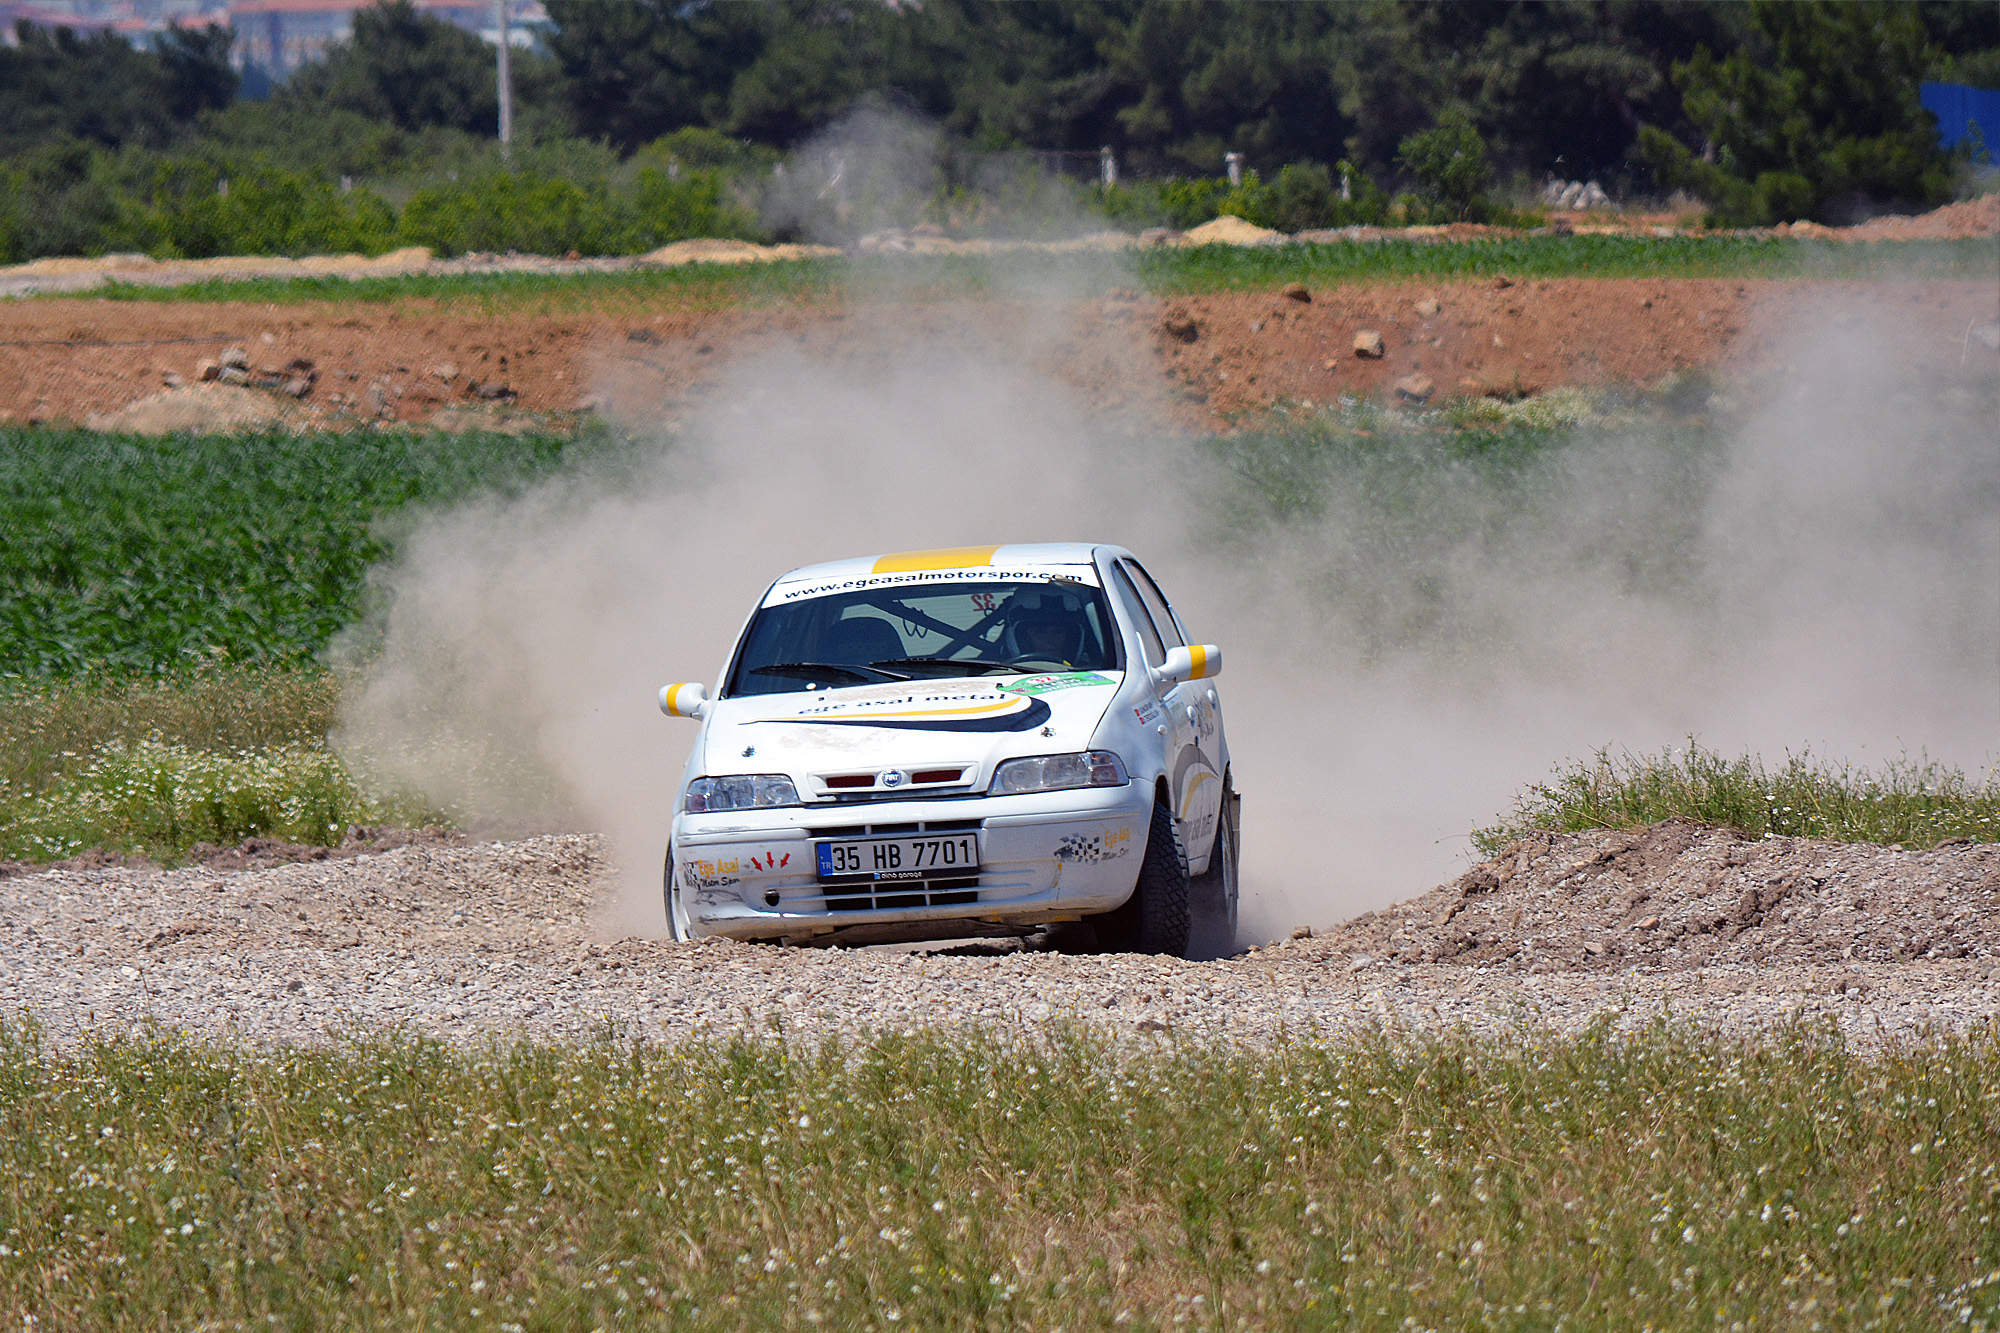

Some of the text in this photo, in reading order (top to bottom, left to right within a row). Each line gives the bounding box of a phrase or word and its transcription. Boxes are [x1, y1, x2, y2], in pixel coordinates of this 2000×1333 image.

[798, 693, 1007, 715] ege asal metal
[821, 861, 832, 870] TR
[832, 839, 970, 872] 35 HB 7701
[698, 857, 740, 879] Ege Asal
